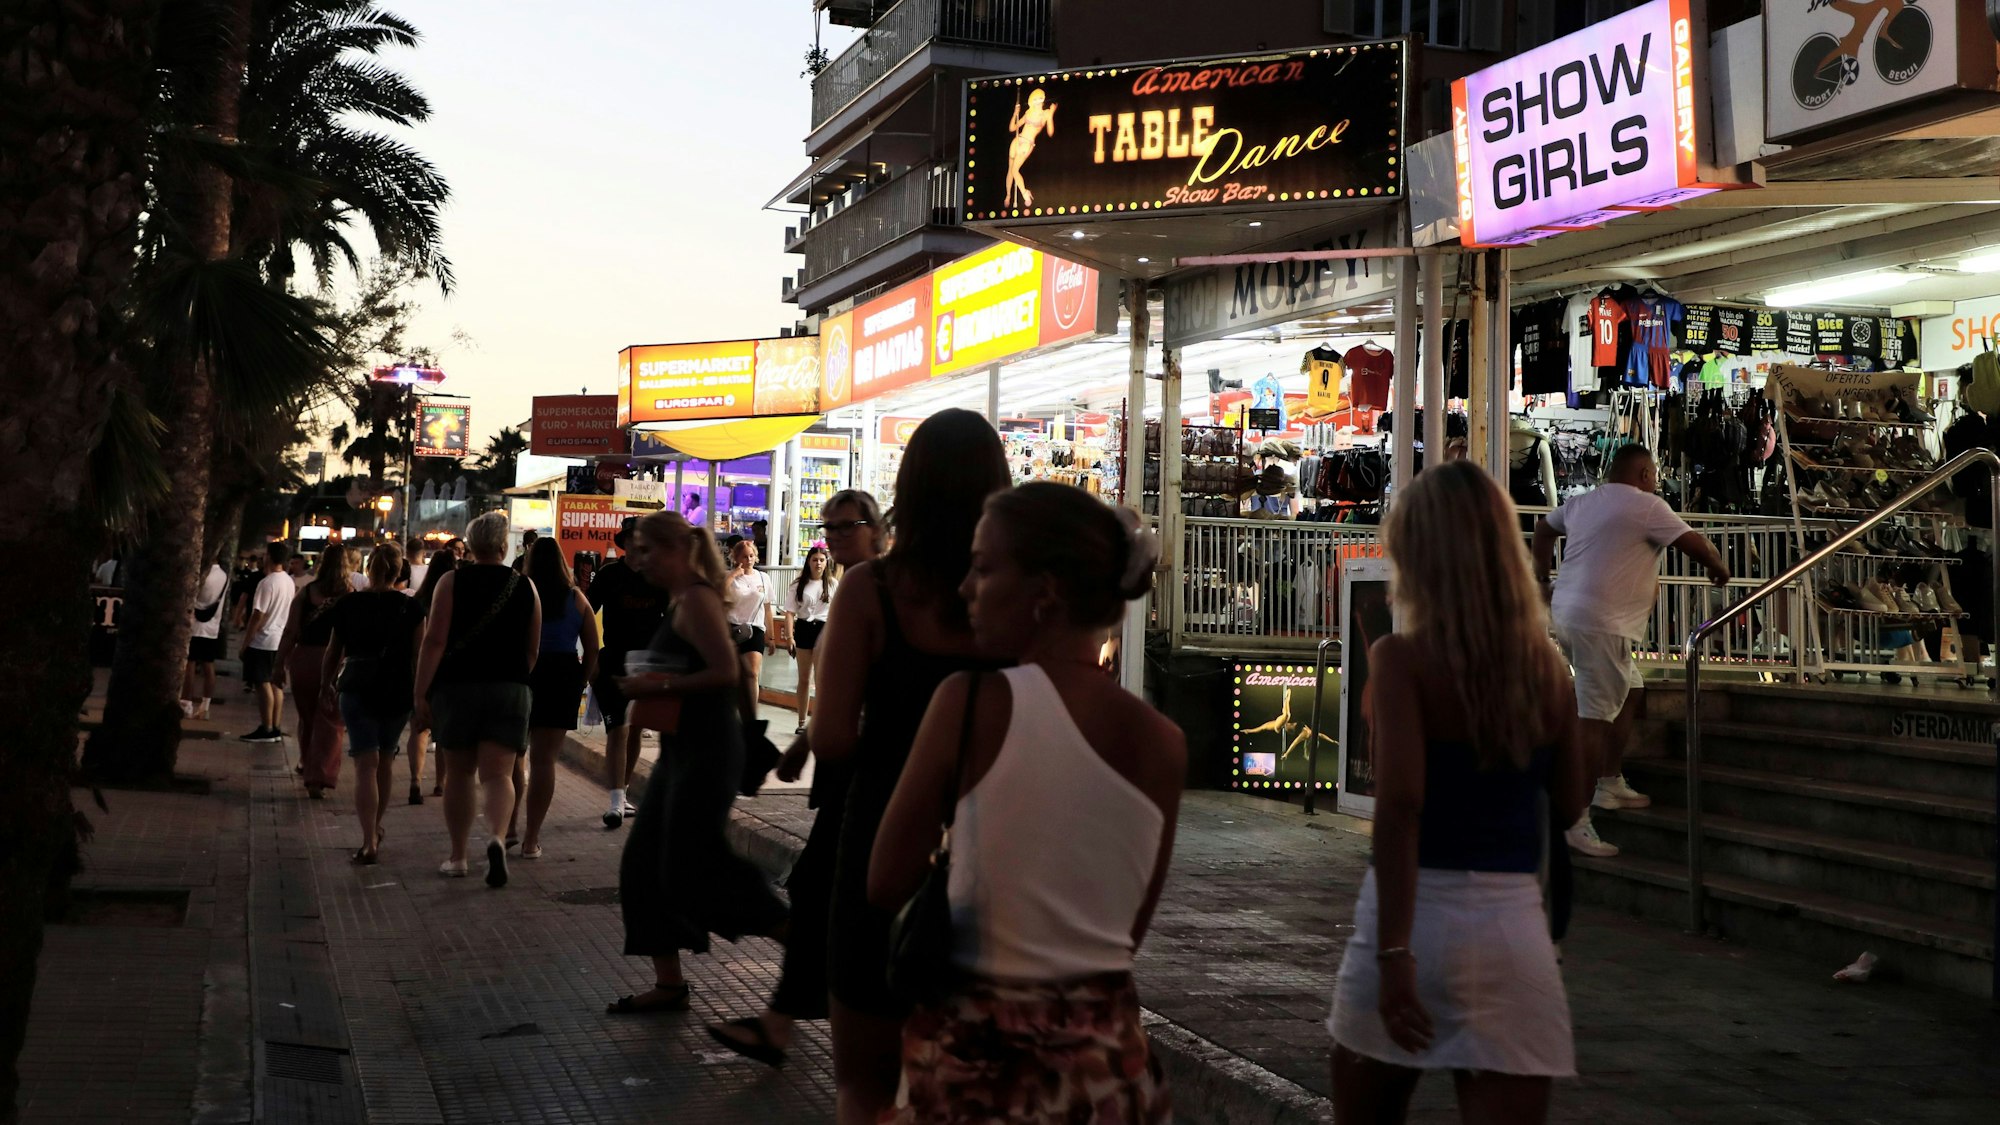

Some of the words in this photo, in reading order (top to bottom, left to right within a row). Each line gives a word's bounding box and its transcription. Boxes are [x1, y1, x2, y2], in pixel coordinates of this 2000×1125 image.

[1132, 60, 1306, 97] American
[1887, 62, 1919, 81] BEQUI
[1482, 32, 1652, 143] SHOW
[1804, 88, 1832, 105] SPORT
[1089, 105, 1215, 164] TABLE
[1188, 118, 1350, 186] Dance
[1492, 114, 1650, 210] GIRLS
[1163, 185, 1220, 206] Show
[1223, 183, 1268, 204] Bar
[1230, 229, 1368, 320] MOREY
[1757, 314, 1773, 327] 50
[1786, 310, 1804, 321] Nach
[1804, 313, 1812, 321] 40
[1816, 318, 1844, 330] BIER
[1879, 318, 1896, 328] GEH
[1600, 319, 1613, 345] 10
[1722, 323, 1739, 341] 50
[1787, 319, 1811, 331] Jahren
[1881, 338, 1902, 350] BIER
[639, 355, 752, 377] SUPERMARKET
[1322, 368, 1330, 390] 9
[1771, 365, 1798, 398] SALES
[1826, 373, 1871, 385] OFERTAS
[655, 397, 723, 409] EUROSPAR
[576, 419, 616, 430] MARKET
[547, 437, 600, 446] EUROSPAR
[563, 501, 598, 510] TABAK
[561, 528, 582, 540] Bei
